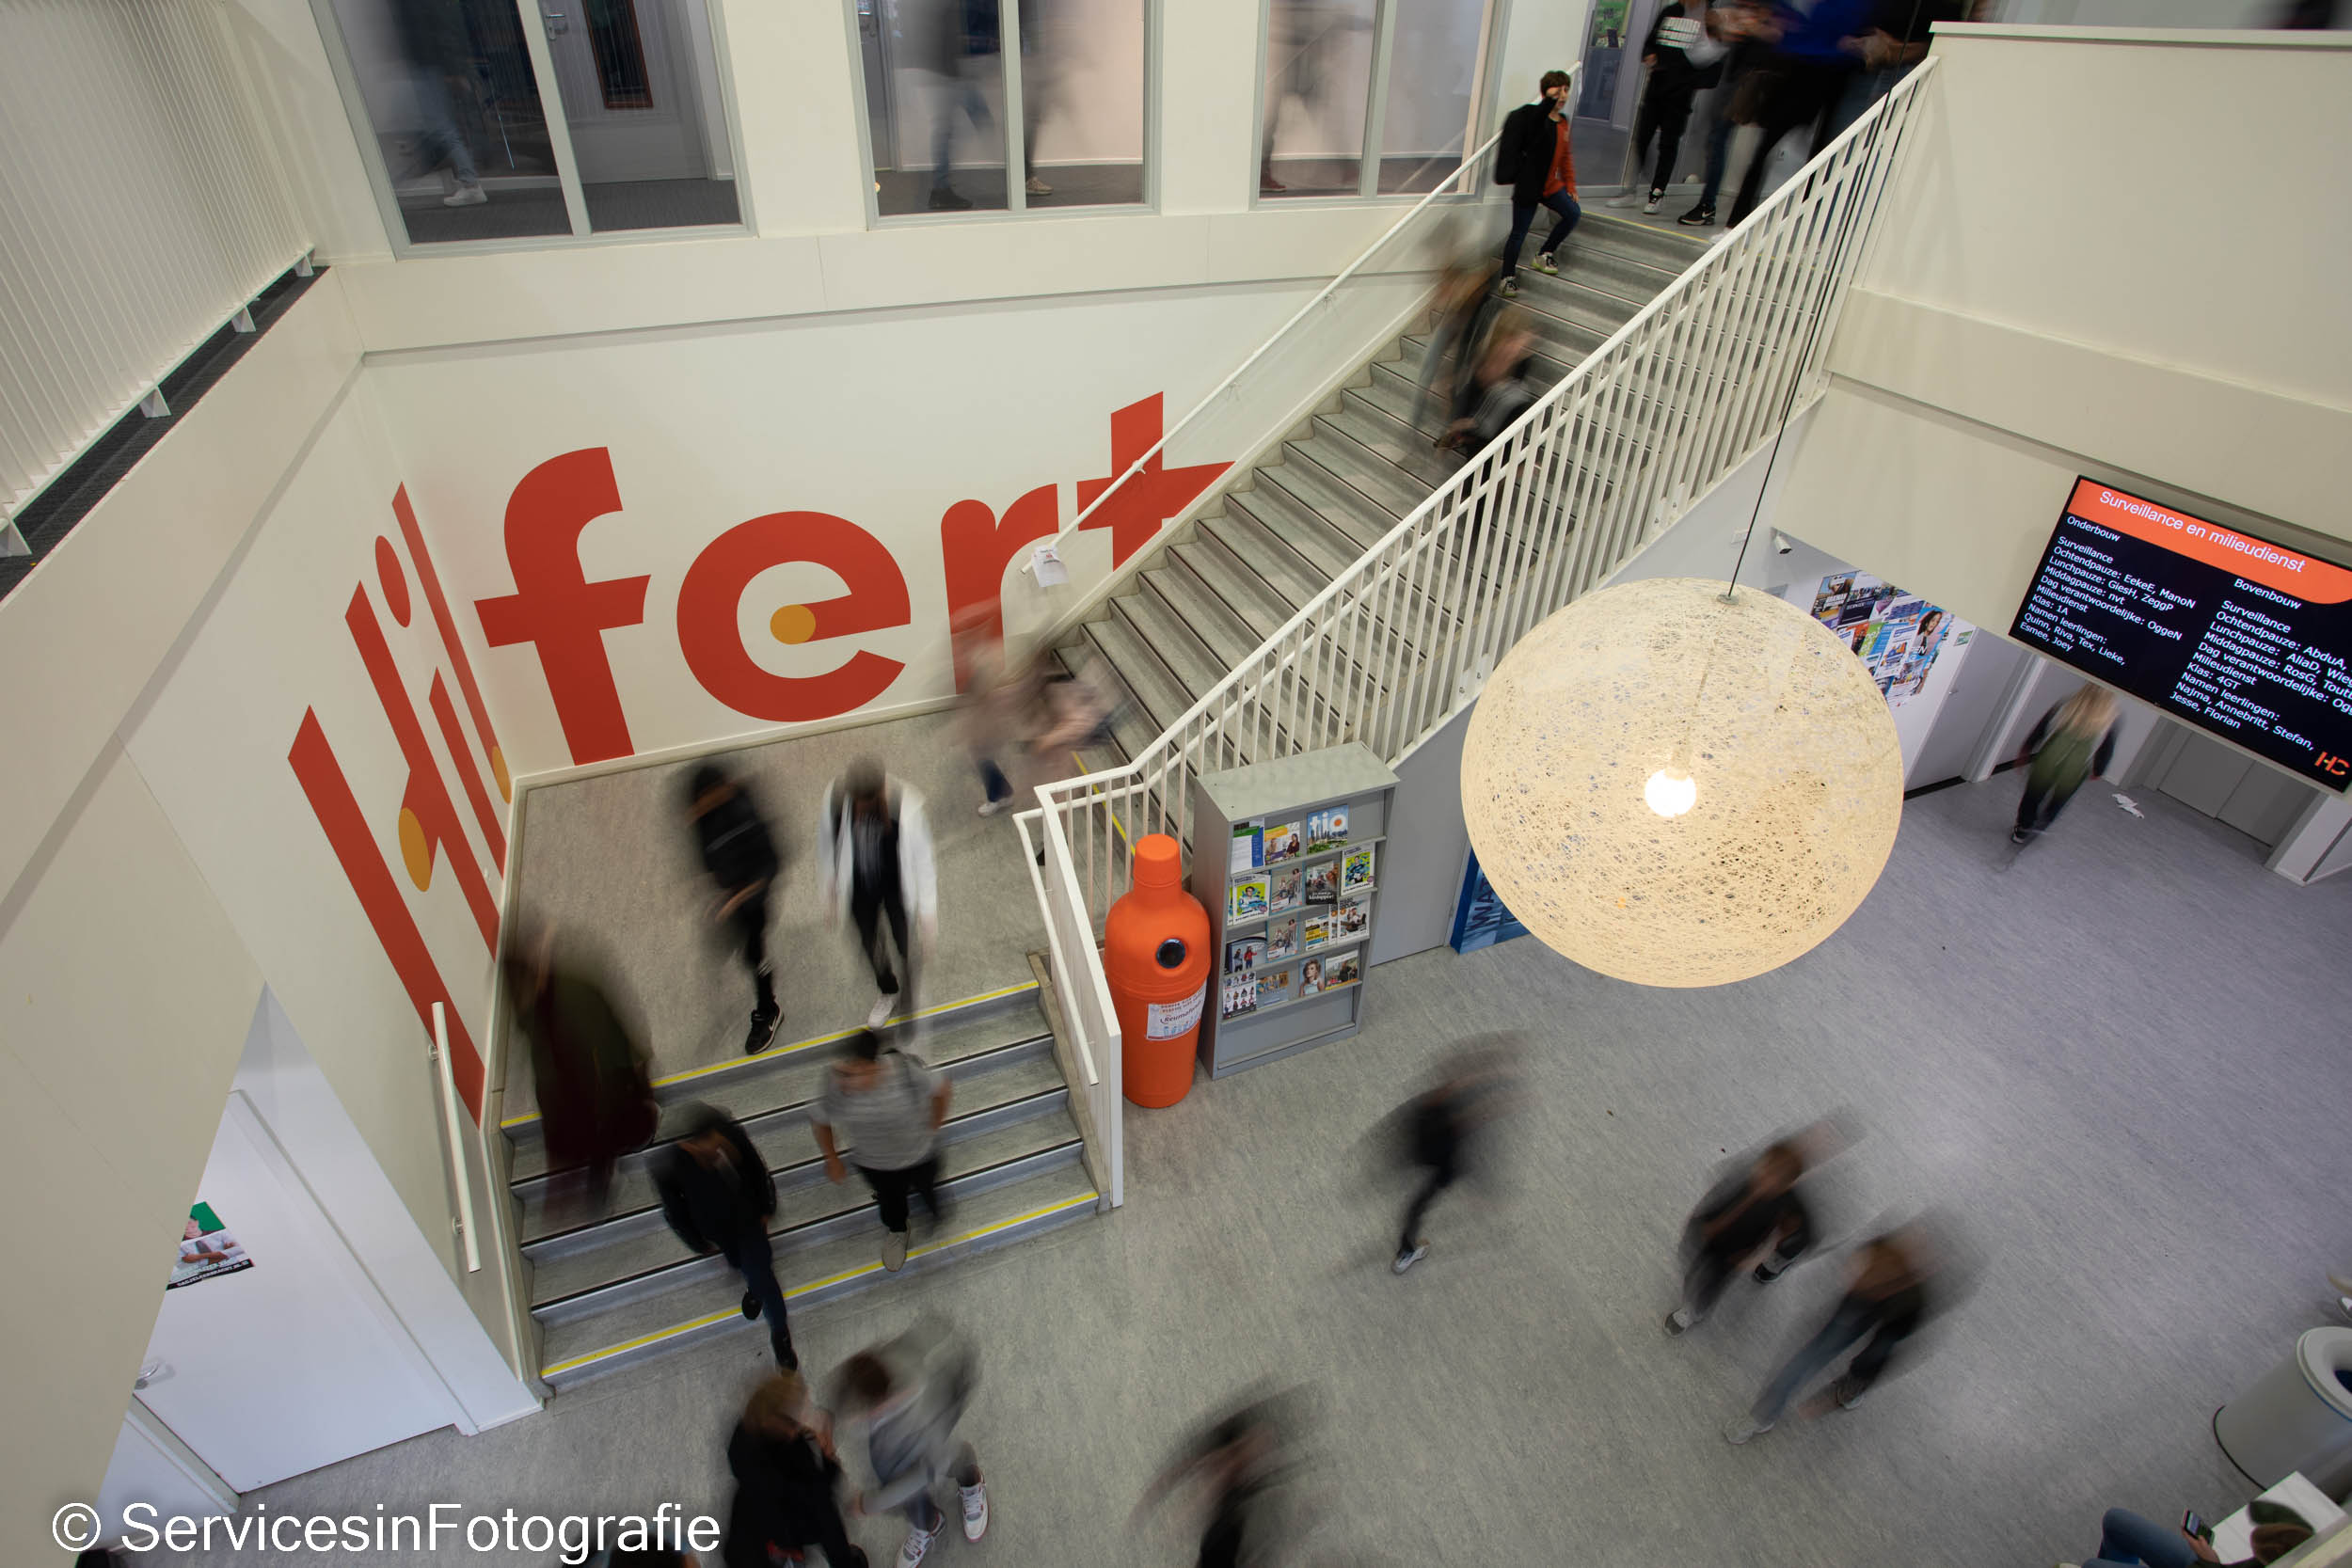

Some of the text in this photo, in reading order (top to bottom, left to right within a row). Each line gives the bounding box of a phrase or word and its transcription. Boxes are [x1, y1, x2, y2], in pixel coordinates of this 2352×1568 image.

[2067, 515, 2121, 542] Onderbouw
[2100, 491, 2306, 573] Surveillance en milieudienst
[2058, 536, 2114, 563] Surveillance
[2036, 584, 2090, 612] Milieudienst
[2044, 565, 2125, 605] Middagpauze: nvt
[2049, 556, 2106, 584] Lunchpauze:
[2140, 594, 2174, 612] ZeggP
[2054, 546, 2196, 610] Ochtendpauze: EekeE, ManoN
[2233, 578, 2301, 610] Bovenbouw
[2027, 603, 2107, 644] Namen leerlingen:
[2032, 594, 2069, 616] Klas: 1A
[2041, 576, 2183, 641] Dag verantwoordelijke: OggeN
[2221, 600, 2292, 633] Surveillance
[2024, 612, 2052, 631] Quinn,
[2077, 636, 2095, 652] Tex,
[2098, 646, 2126, 665] Lieke,
[2052, 637, 2074, 652] Joey
[2204, 631, 2280, 669] Middagpauze:
[2283, 664, 2317, 686] RosG,
[2209, 621, 2280, 656] Lunchpauze:
[2216, 610, 2347, 671] Ochtendpauze: AbduA,
[2186, 662, 2241, 689] Klas: 4GT
[2192, 652, 2257, 686] Milieudienst
[2198, 641, 2220, 658] Dag
[2223, 653, 2329, 703] verantwoordelijke:
[2169, 691, 2242, 729] Jesse, Florian
[2181, 672, 2280, 721] Namen leerlingen:
[2175, 682, 2314, 752] Najma, Annebritt, Stefan,
